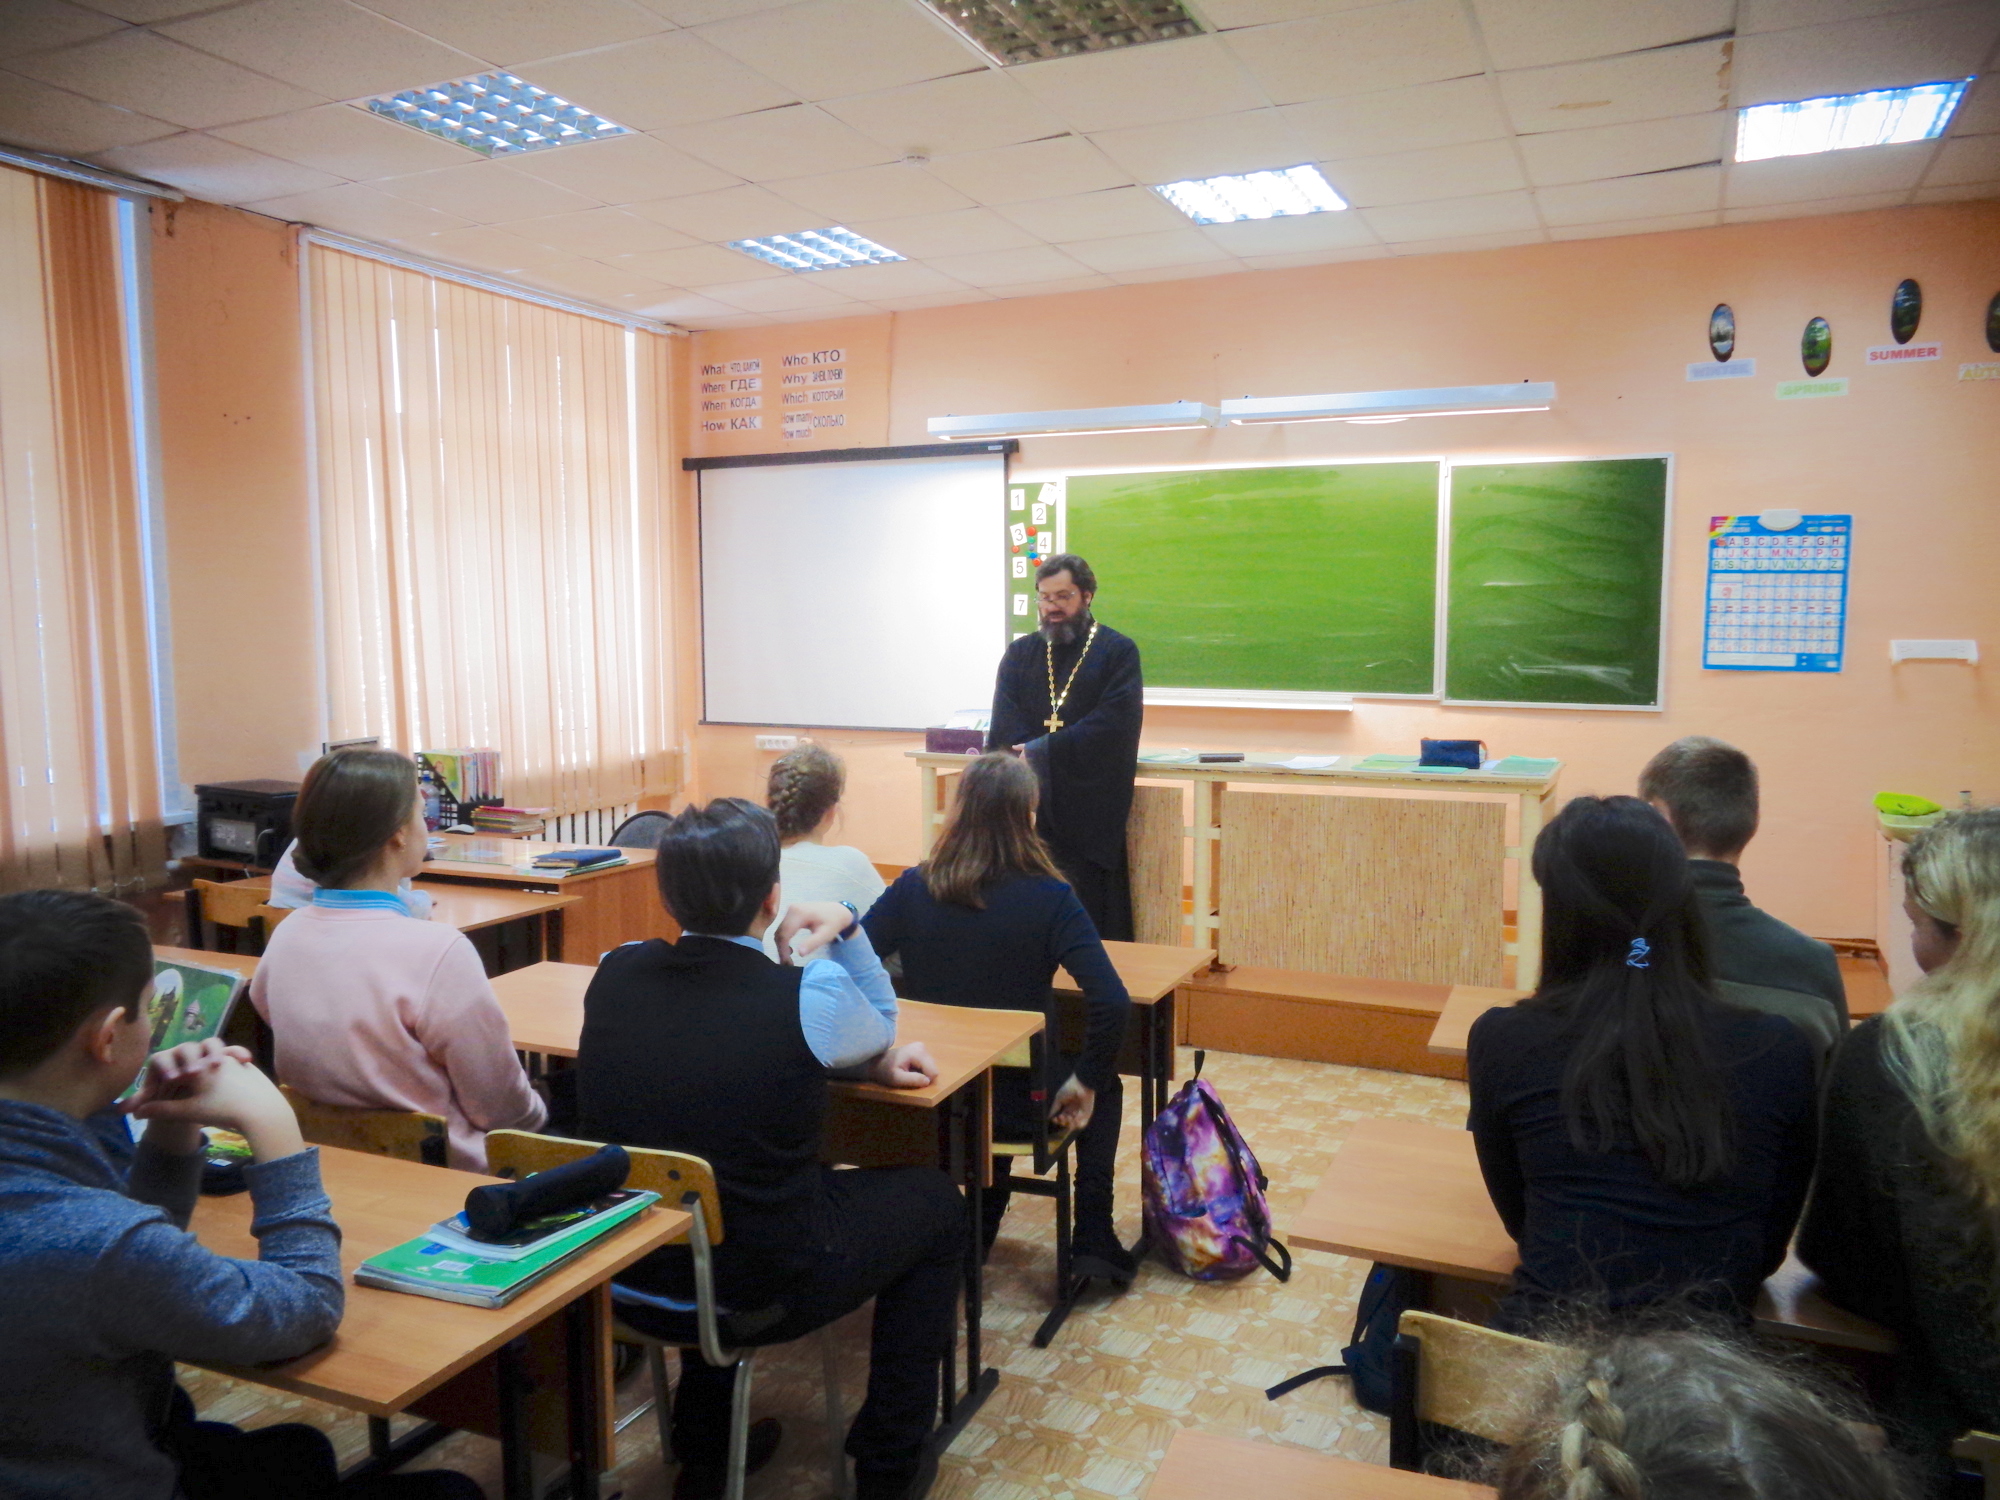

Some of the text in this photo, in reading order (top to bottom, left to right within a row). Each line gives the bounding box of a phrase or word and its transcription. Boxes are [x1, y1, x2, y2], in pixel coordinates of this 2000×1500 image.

[782, 350, 840, 366] Who КТО
[1869, 346, 1938, 361] SUMMER
[701, 365, 726, 376] What
[701, 378, 756, 394] Where ГДЕ
[782, 374, 808, 385] Why
[1783, 382, 1841, 395] SPRING
[782, 388, 843, 404] Which КОТОРЫЙ
[701, 398, 756, 411] When КОГДА
[701, 417, 756, 431] How КАК
[813, 415, 844, 428] СКОЛЬКО
